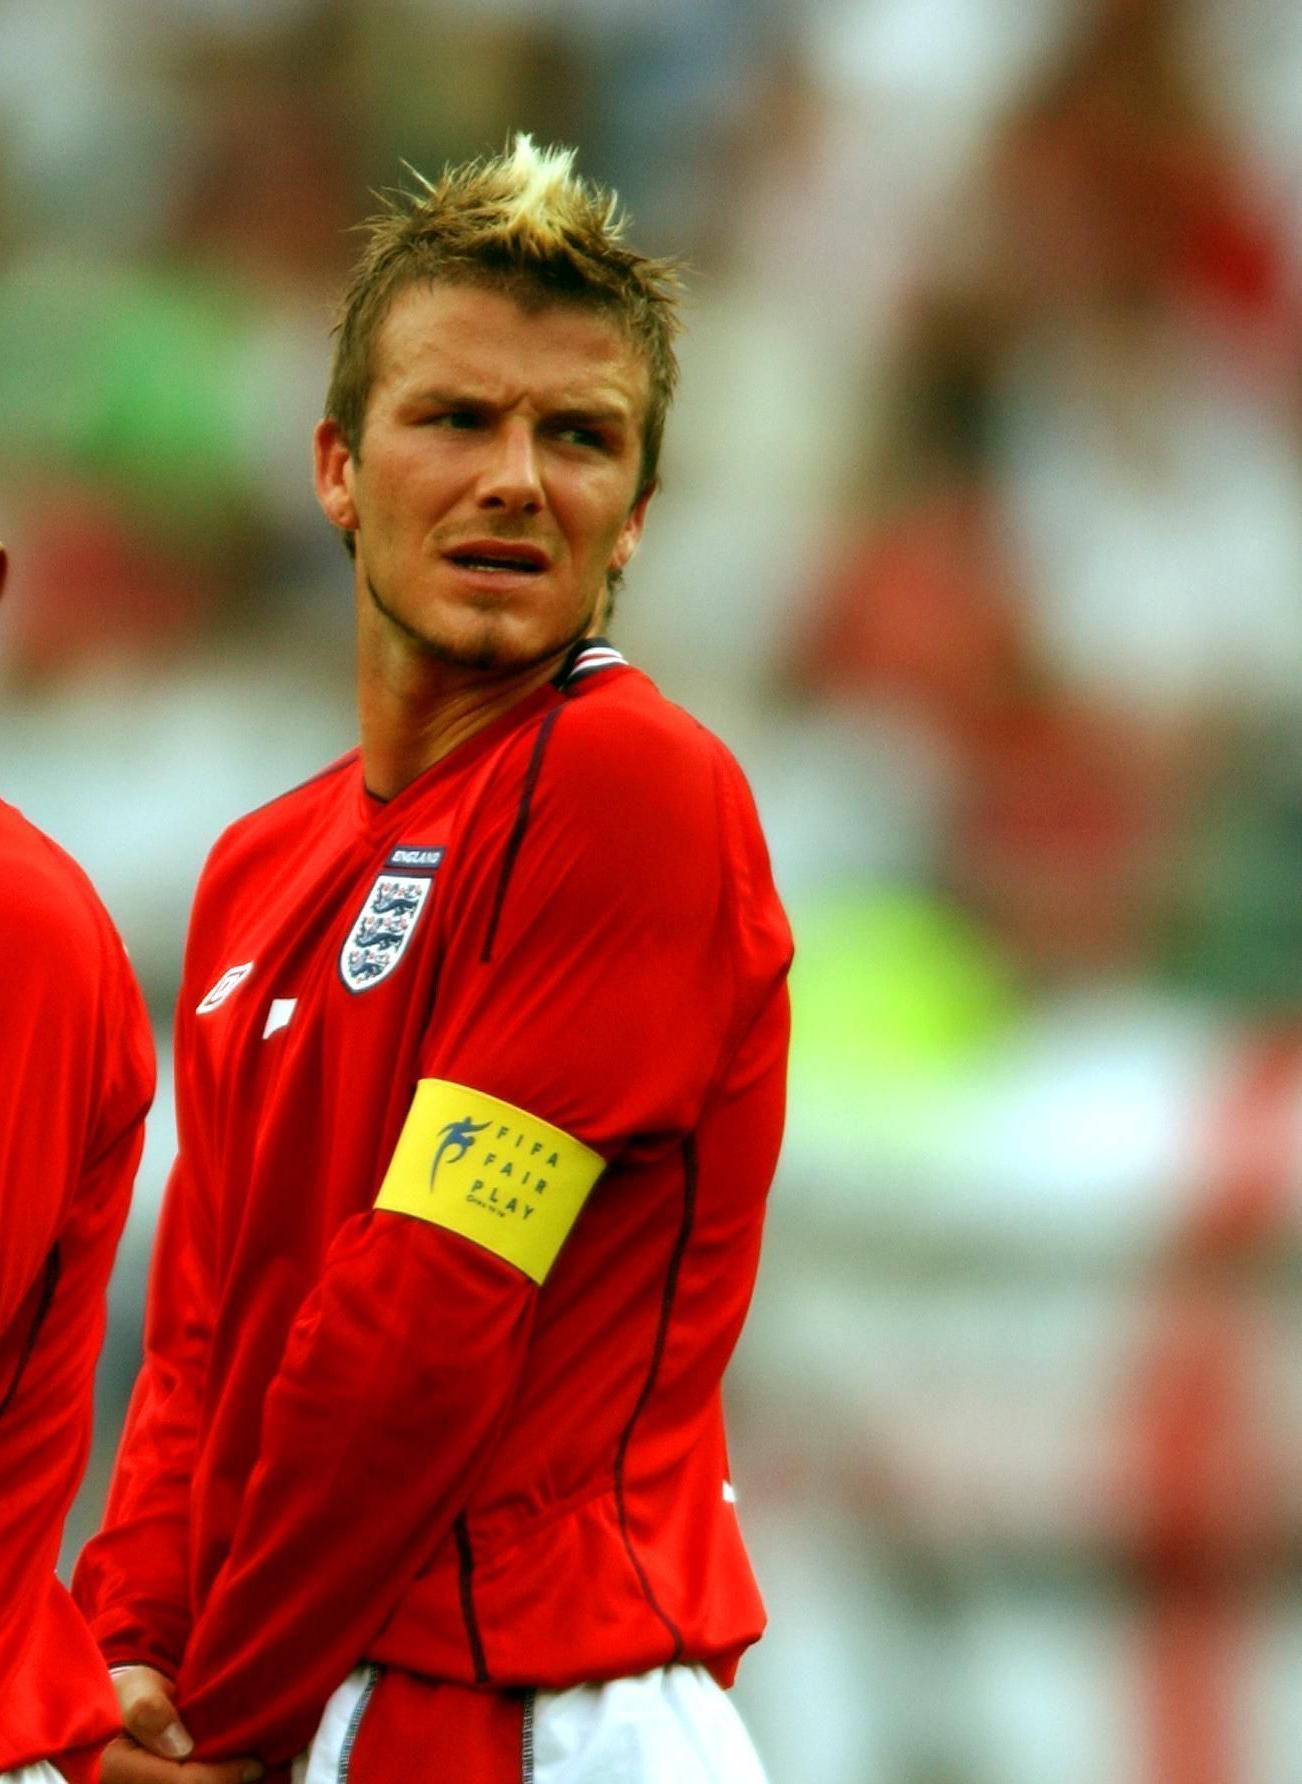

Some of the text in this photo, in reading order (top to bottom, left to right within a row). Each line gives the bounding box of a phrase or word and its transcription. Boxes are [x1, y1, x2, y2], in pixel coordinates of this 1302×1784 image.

[392, 850, 441, 864] ENGLAND
[497, 1126, 558, 1167] FIFA
[484, 1153, 547, 1194] FAIR
[471, 1179, 534, 1220] PLAY
